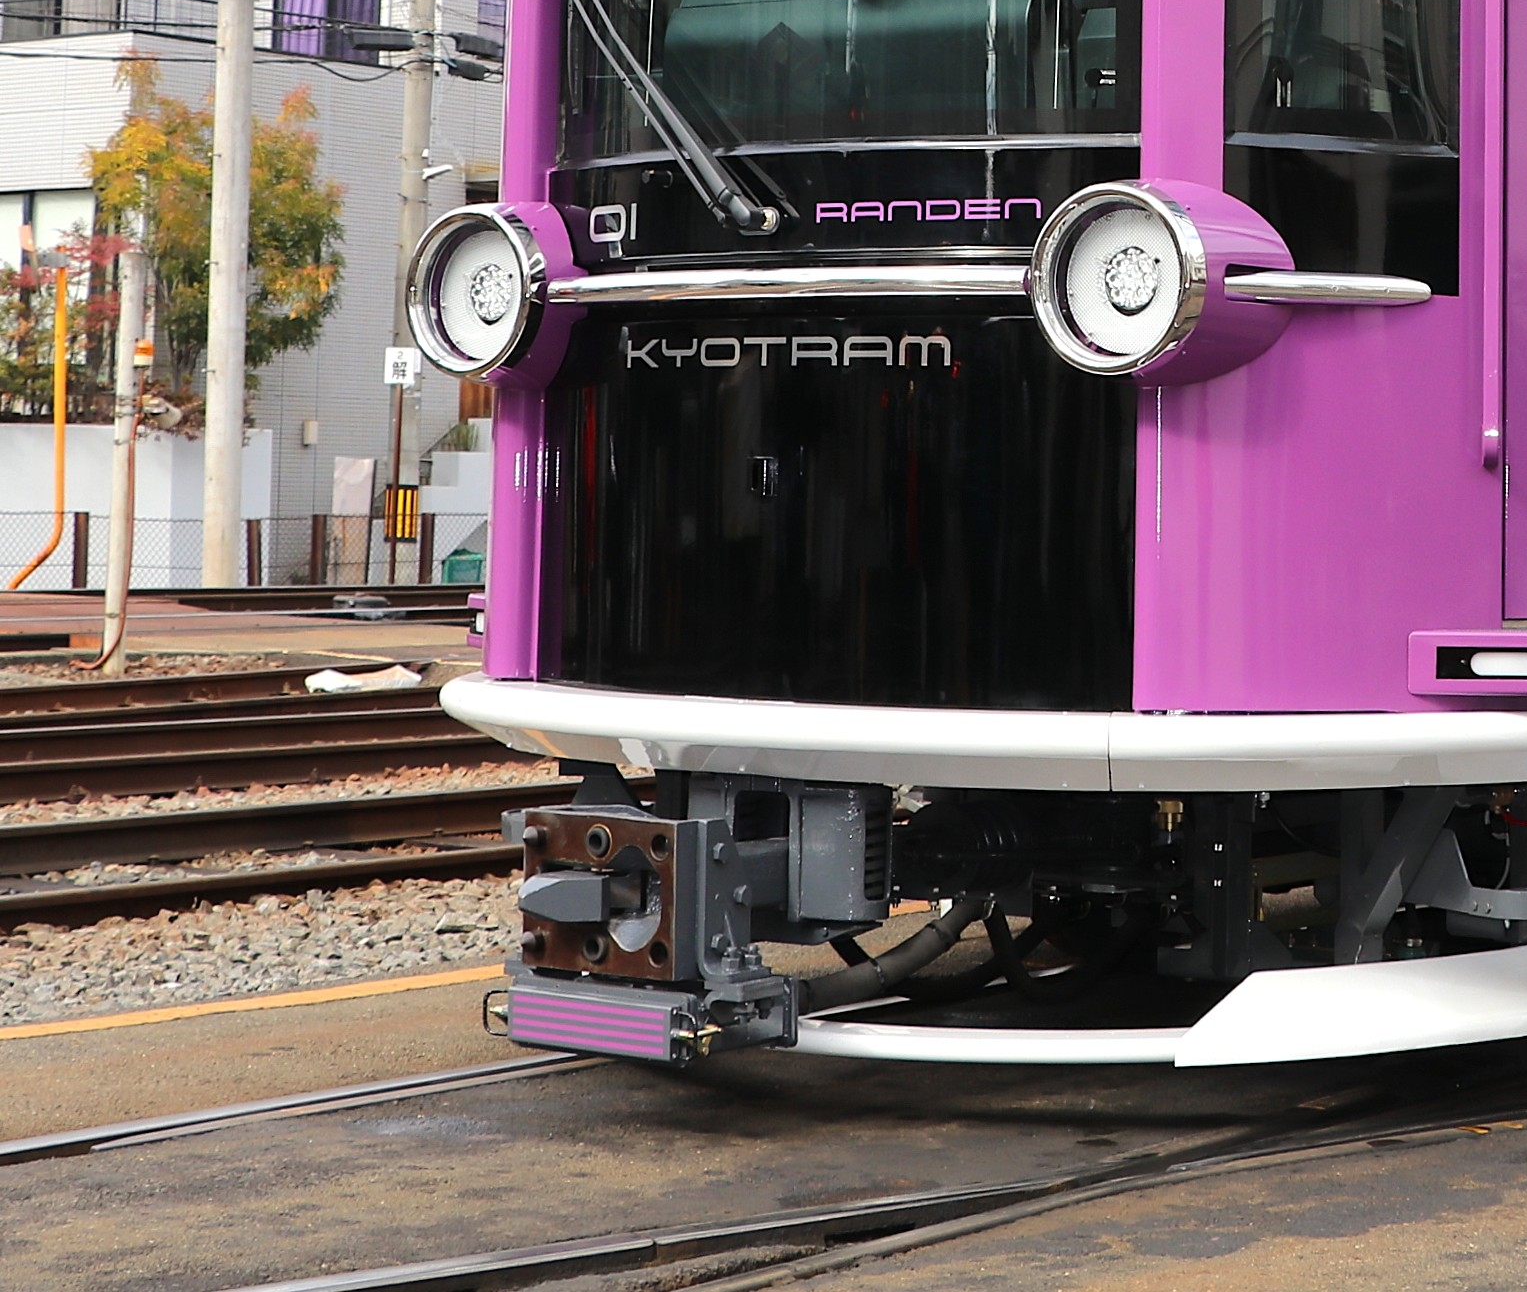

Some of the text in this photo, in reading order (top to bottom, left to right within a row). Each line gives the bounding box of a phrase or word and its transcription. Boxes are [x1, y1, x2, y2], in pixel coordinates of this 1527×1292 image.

[589, 202, 637, 243] 01
[815, 198, 1042, 223] RANDEN
[397, 350, 404, 360] 2
[626, 335, 952, 369] KYOTRAM
[391, 360, 408, 380] 解
